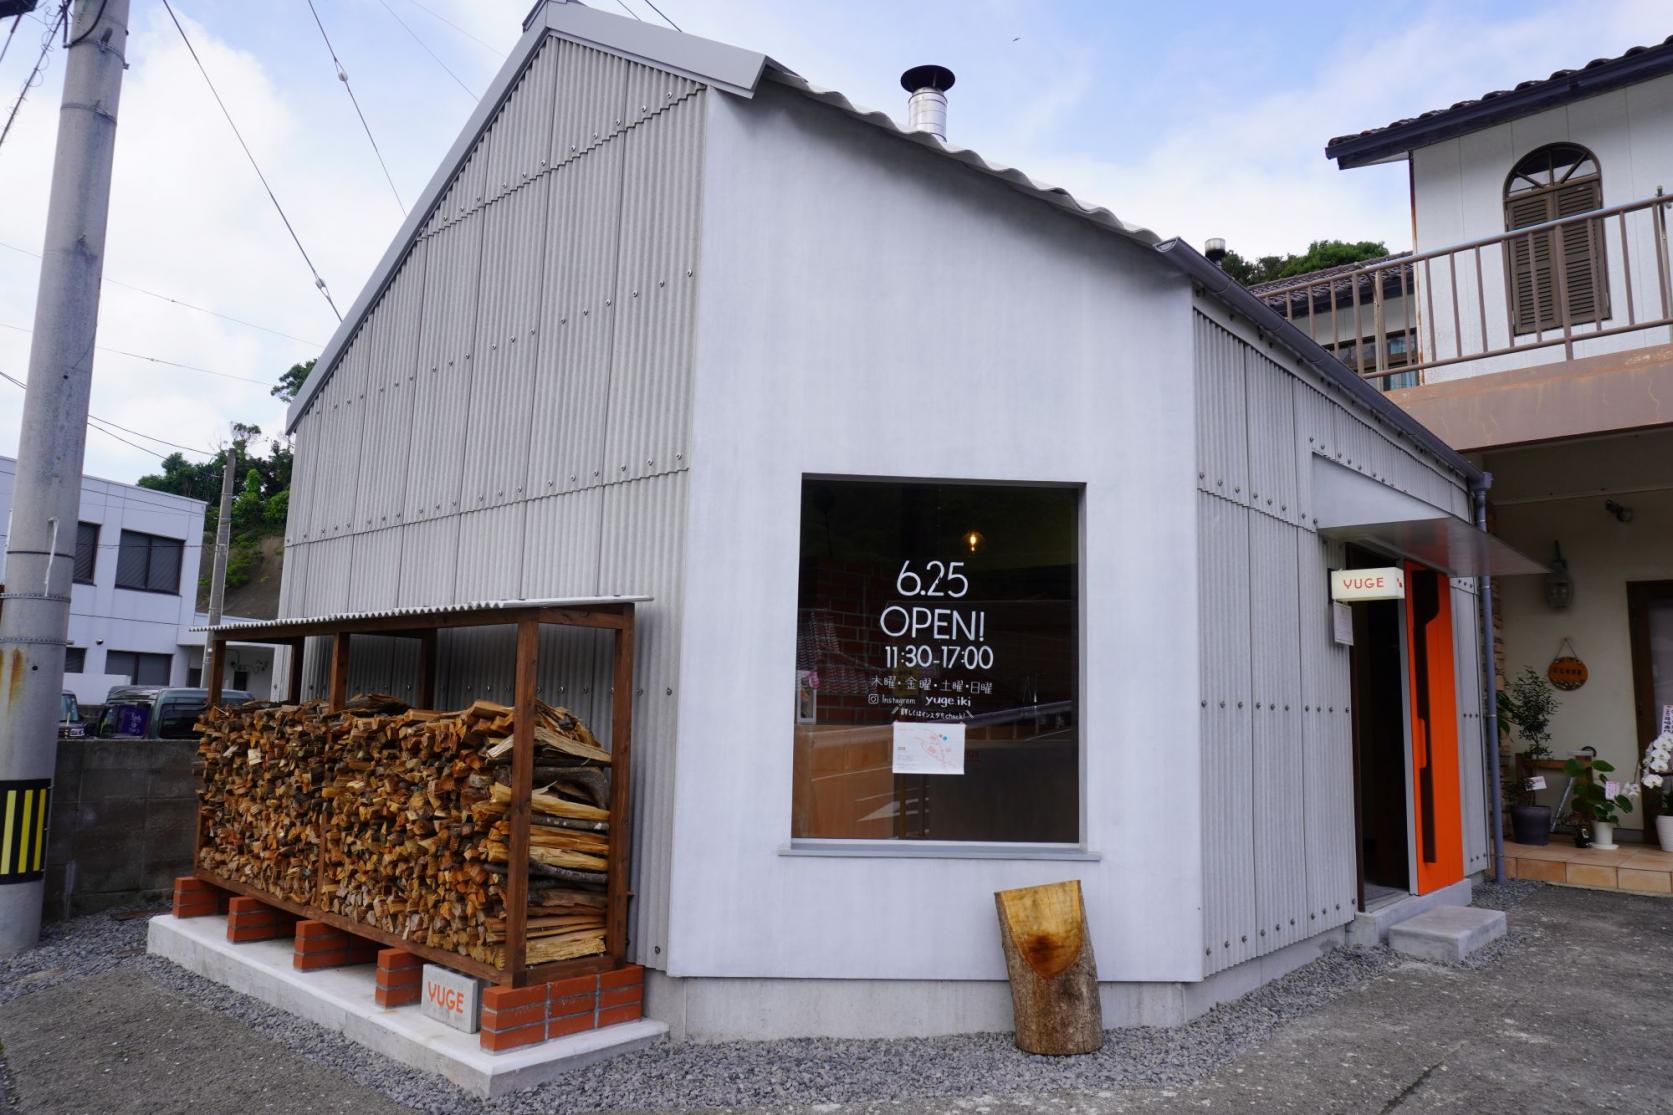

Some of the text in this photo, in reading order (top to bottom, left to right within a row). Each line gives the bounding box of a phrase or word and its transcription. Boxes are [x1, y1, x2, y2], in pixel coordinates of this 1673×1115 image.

[897, 560, 968, 598] 6.25
[1343, 577, 1384, 589] YUGE
[880, 606, 985, 641] OPEN!
[885, 645, 994, 670] 11:30-17:00
[881, 694, 916, 707] Instagram
[427, 981, 464, 1014] YUGE
